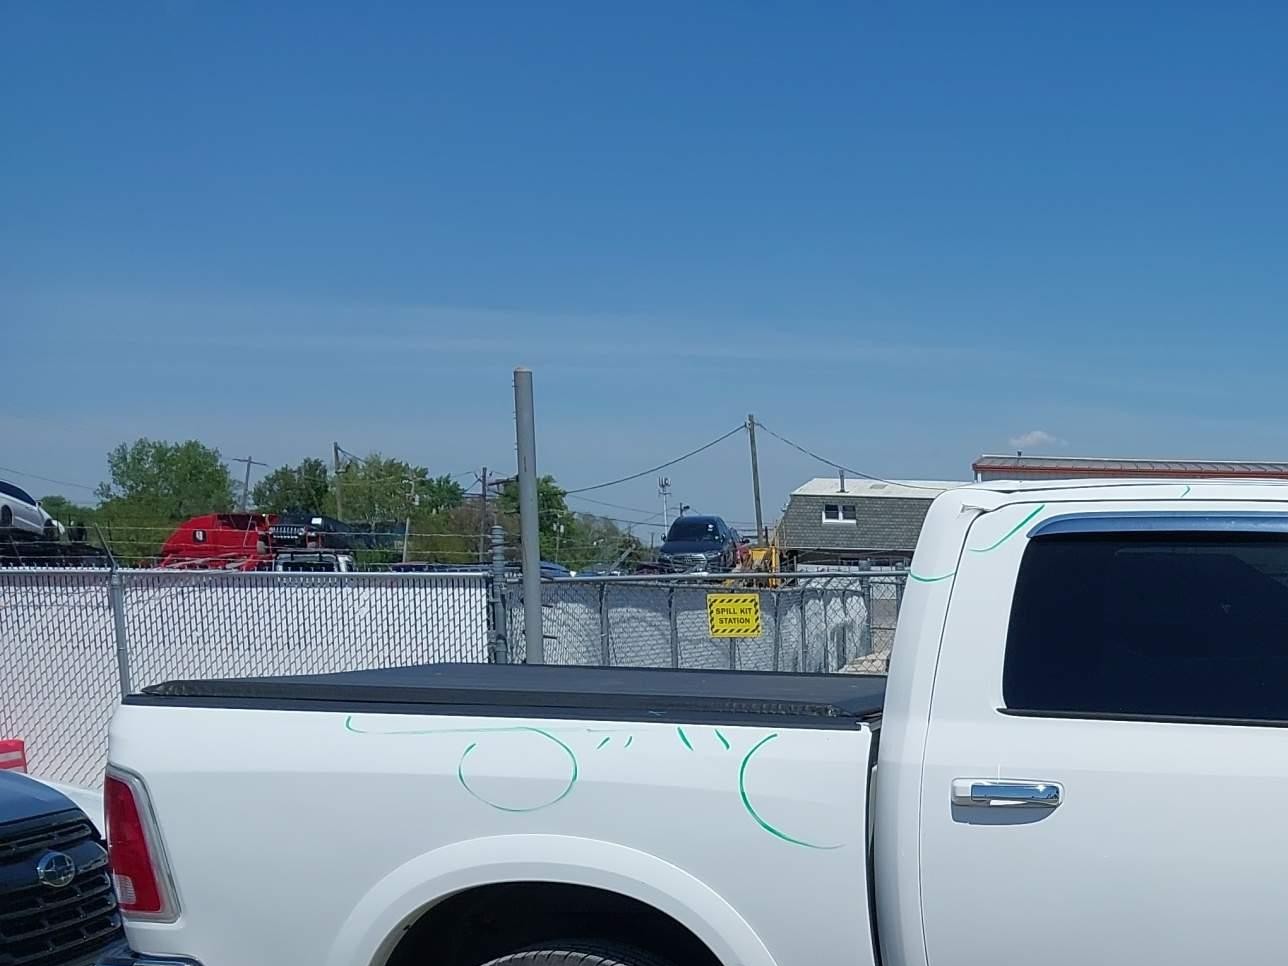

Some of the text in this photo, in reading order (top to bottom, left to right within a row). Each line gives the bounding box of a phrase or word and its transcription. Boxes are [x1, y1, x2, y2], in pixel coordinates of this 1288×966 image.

[716, 607, 752, 615] SPILL KIT
[718, 617, 750, 625] STATION
